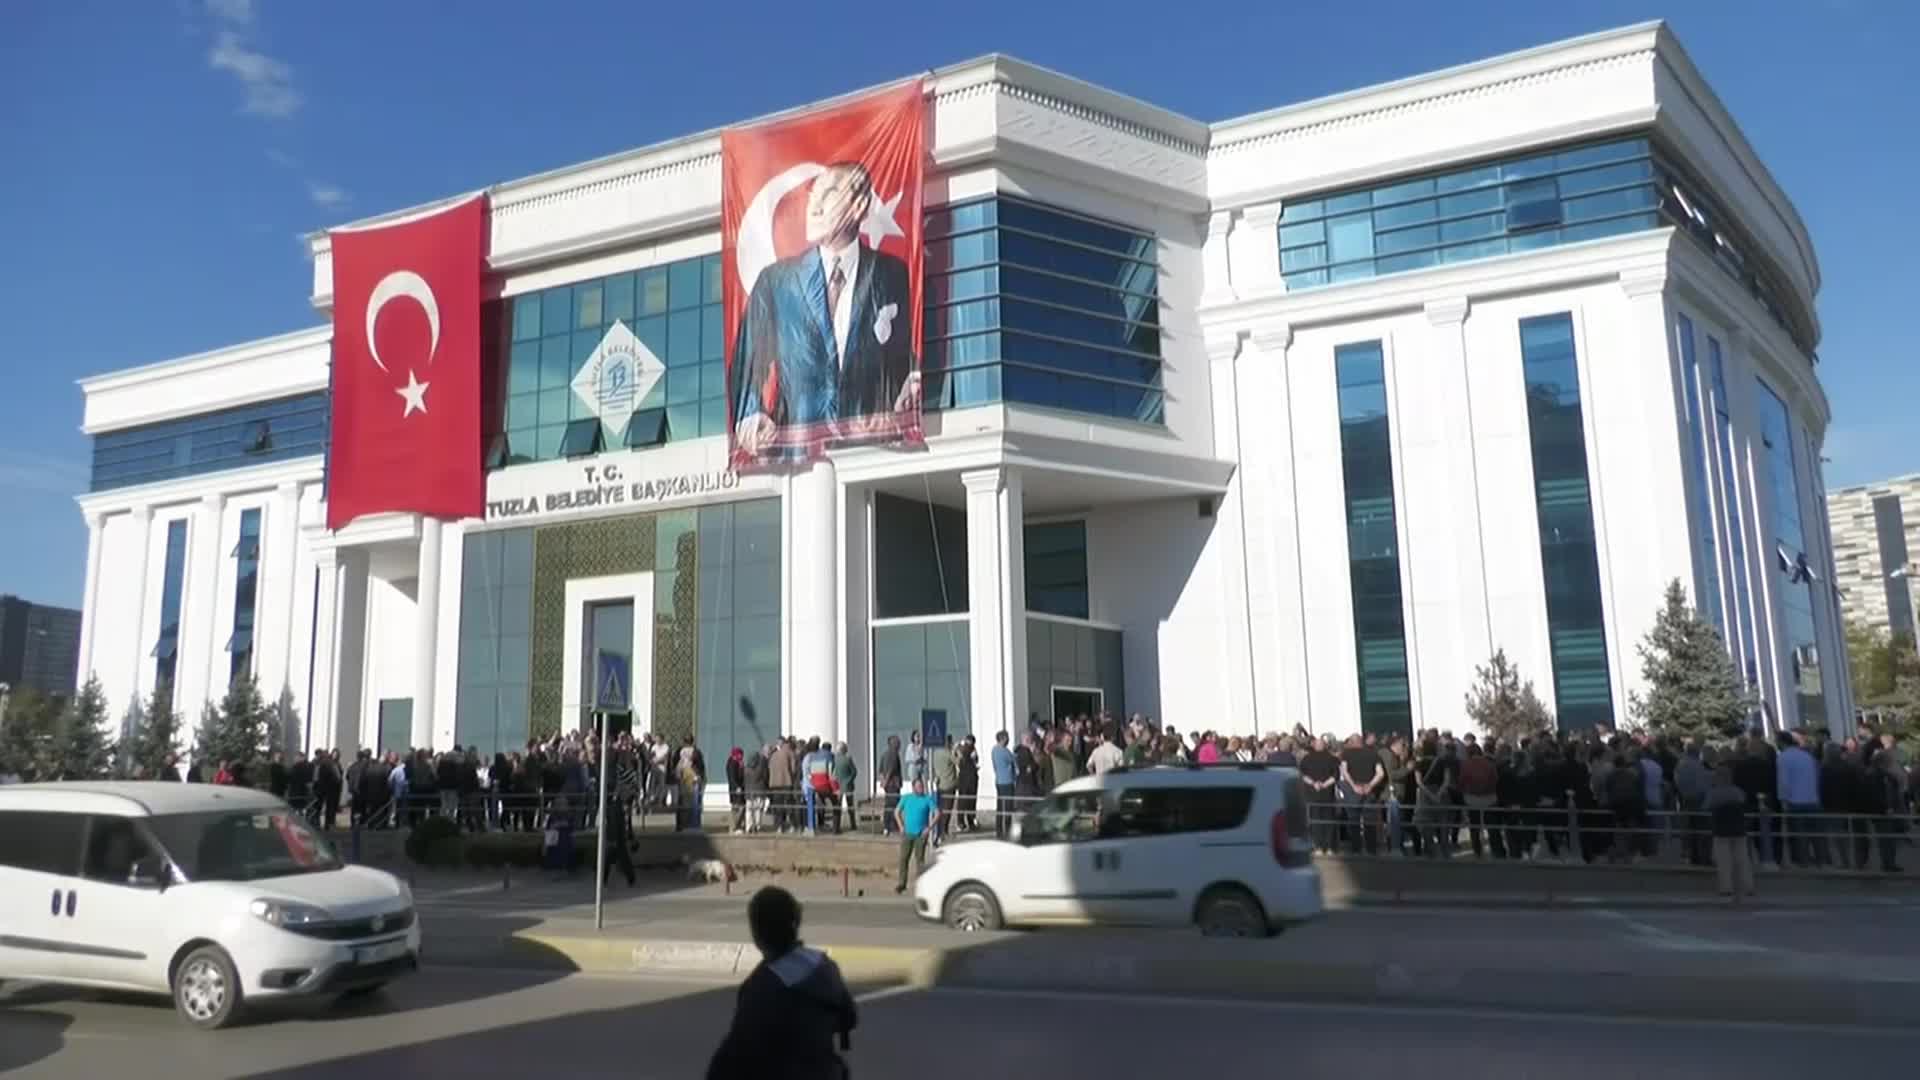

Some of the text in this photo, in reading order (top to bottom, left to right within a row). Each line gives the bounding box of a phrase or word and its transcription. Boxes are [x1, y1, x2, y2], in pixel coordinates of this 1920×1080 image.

[487, 471, 741, 517] TUZLA BELEDİYE BAŞKANLIĞI
